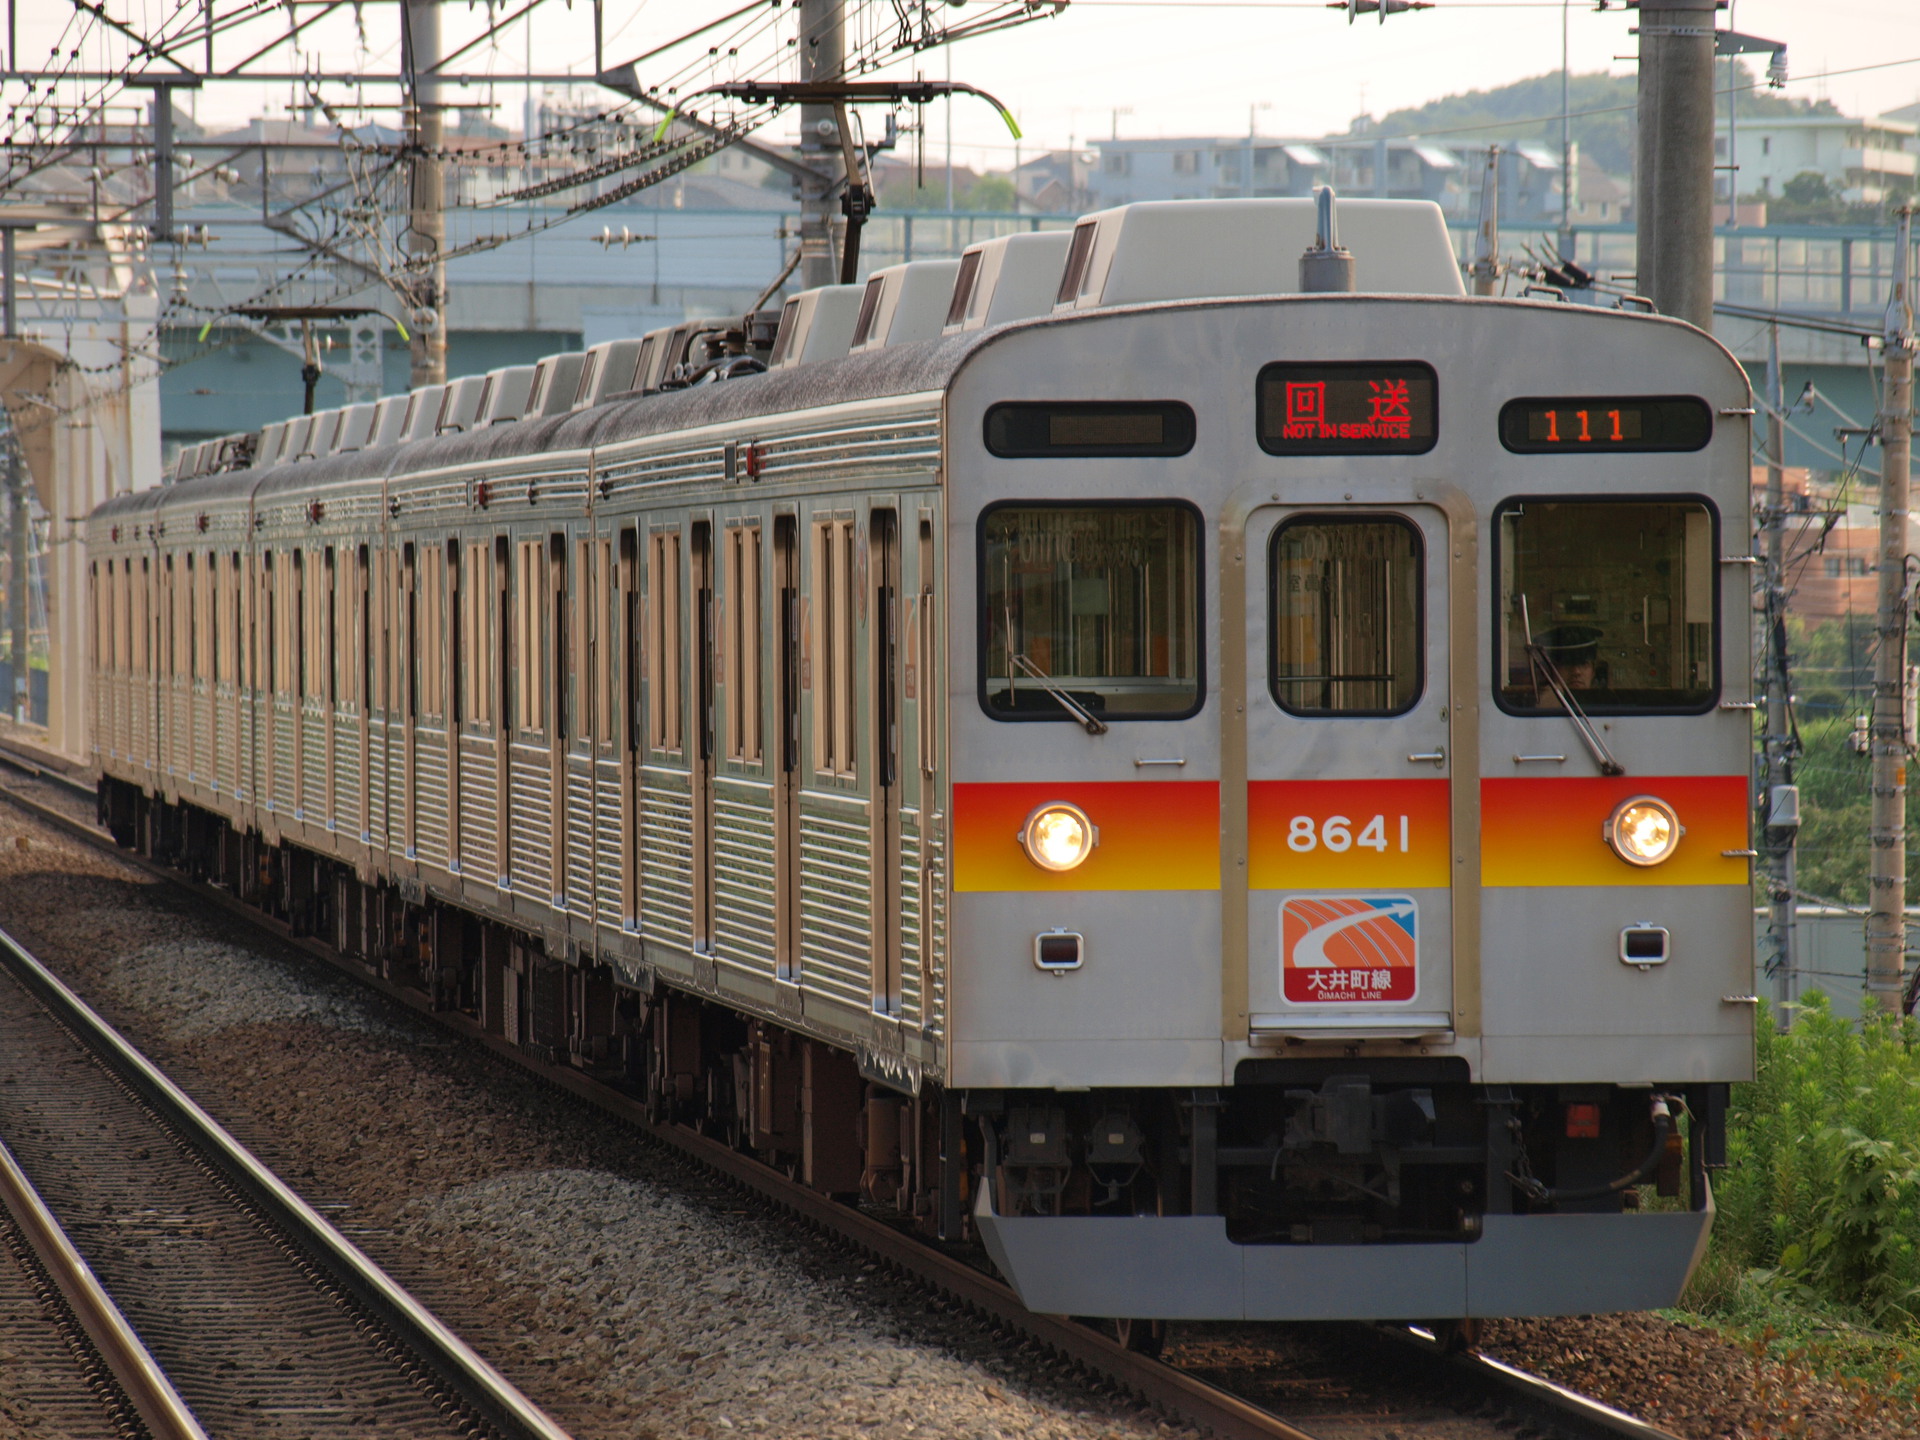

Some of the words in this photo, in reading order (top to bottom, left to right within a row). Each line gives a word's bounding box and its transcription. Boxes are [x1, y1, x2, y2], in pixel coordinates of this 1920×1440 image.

[1286, 379, 1412, 424] 回送
[1283, 424, 1315, 439] NOT
[1319, 424, 1337, 439] IN
[1339, 423, 1411, 439] SERVICE
[1545, 409, 1623, 442] 111
[1287, 814, 1409, 853] 8641
[1307, 969, 1392, 991] 大井町線
[1361, 991, 1382, 1000] LINE
